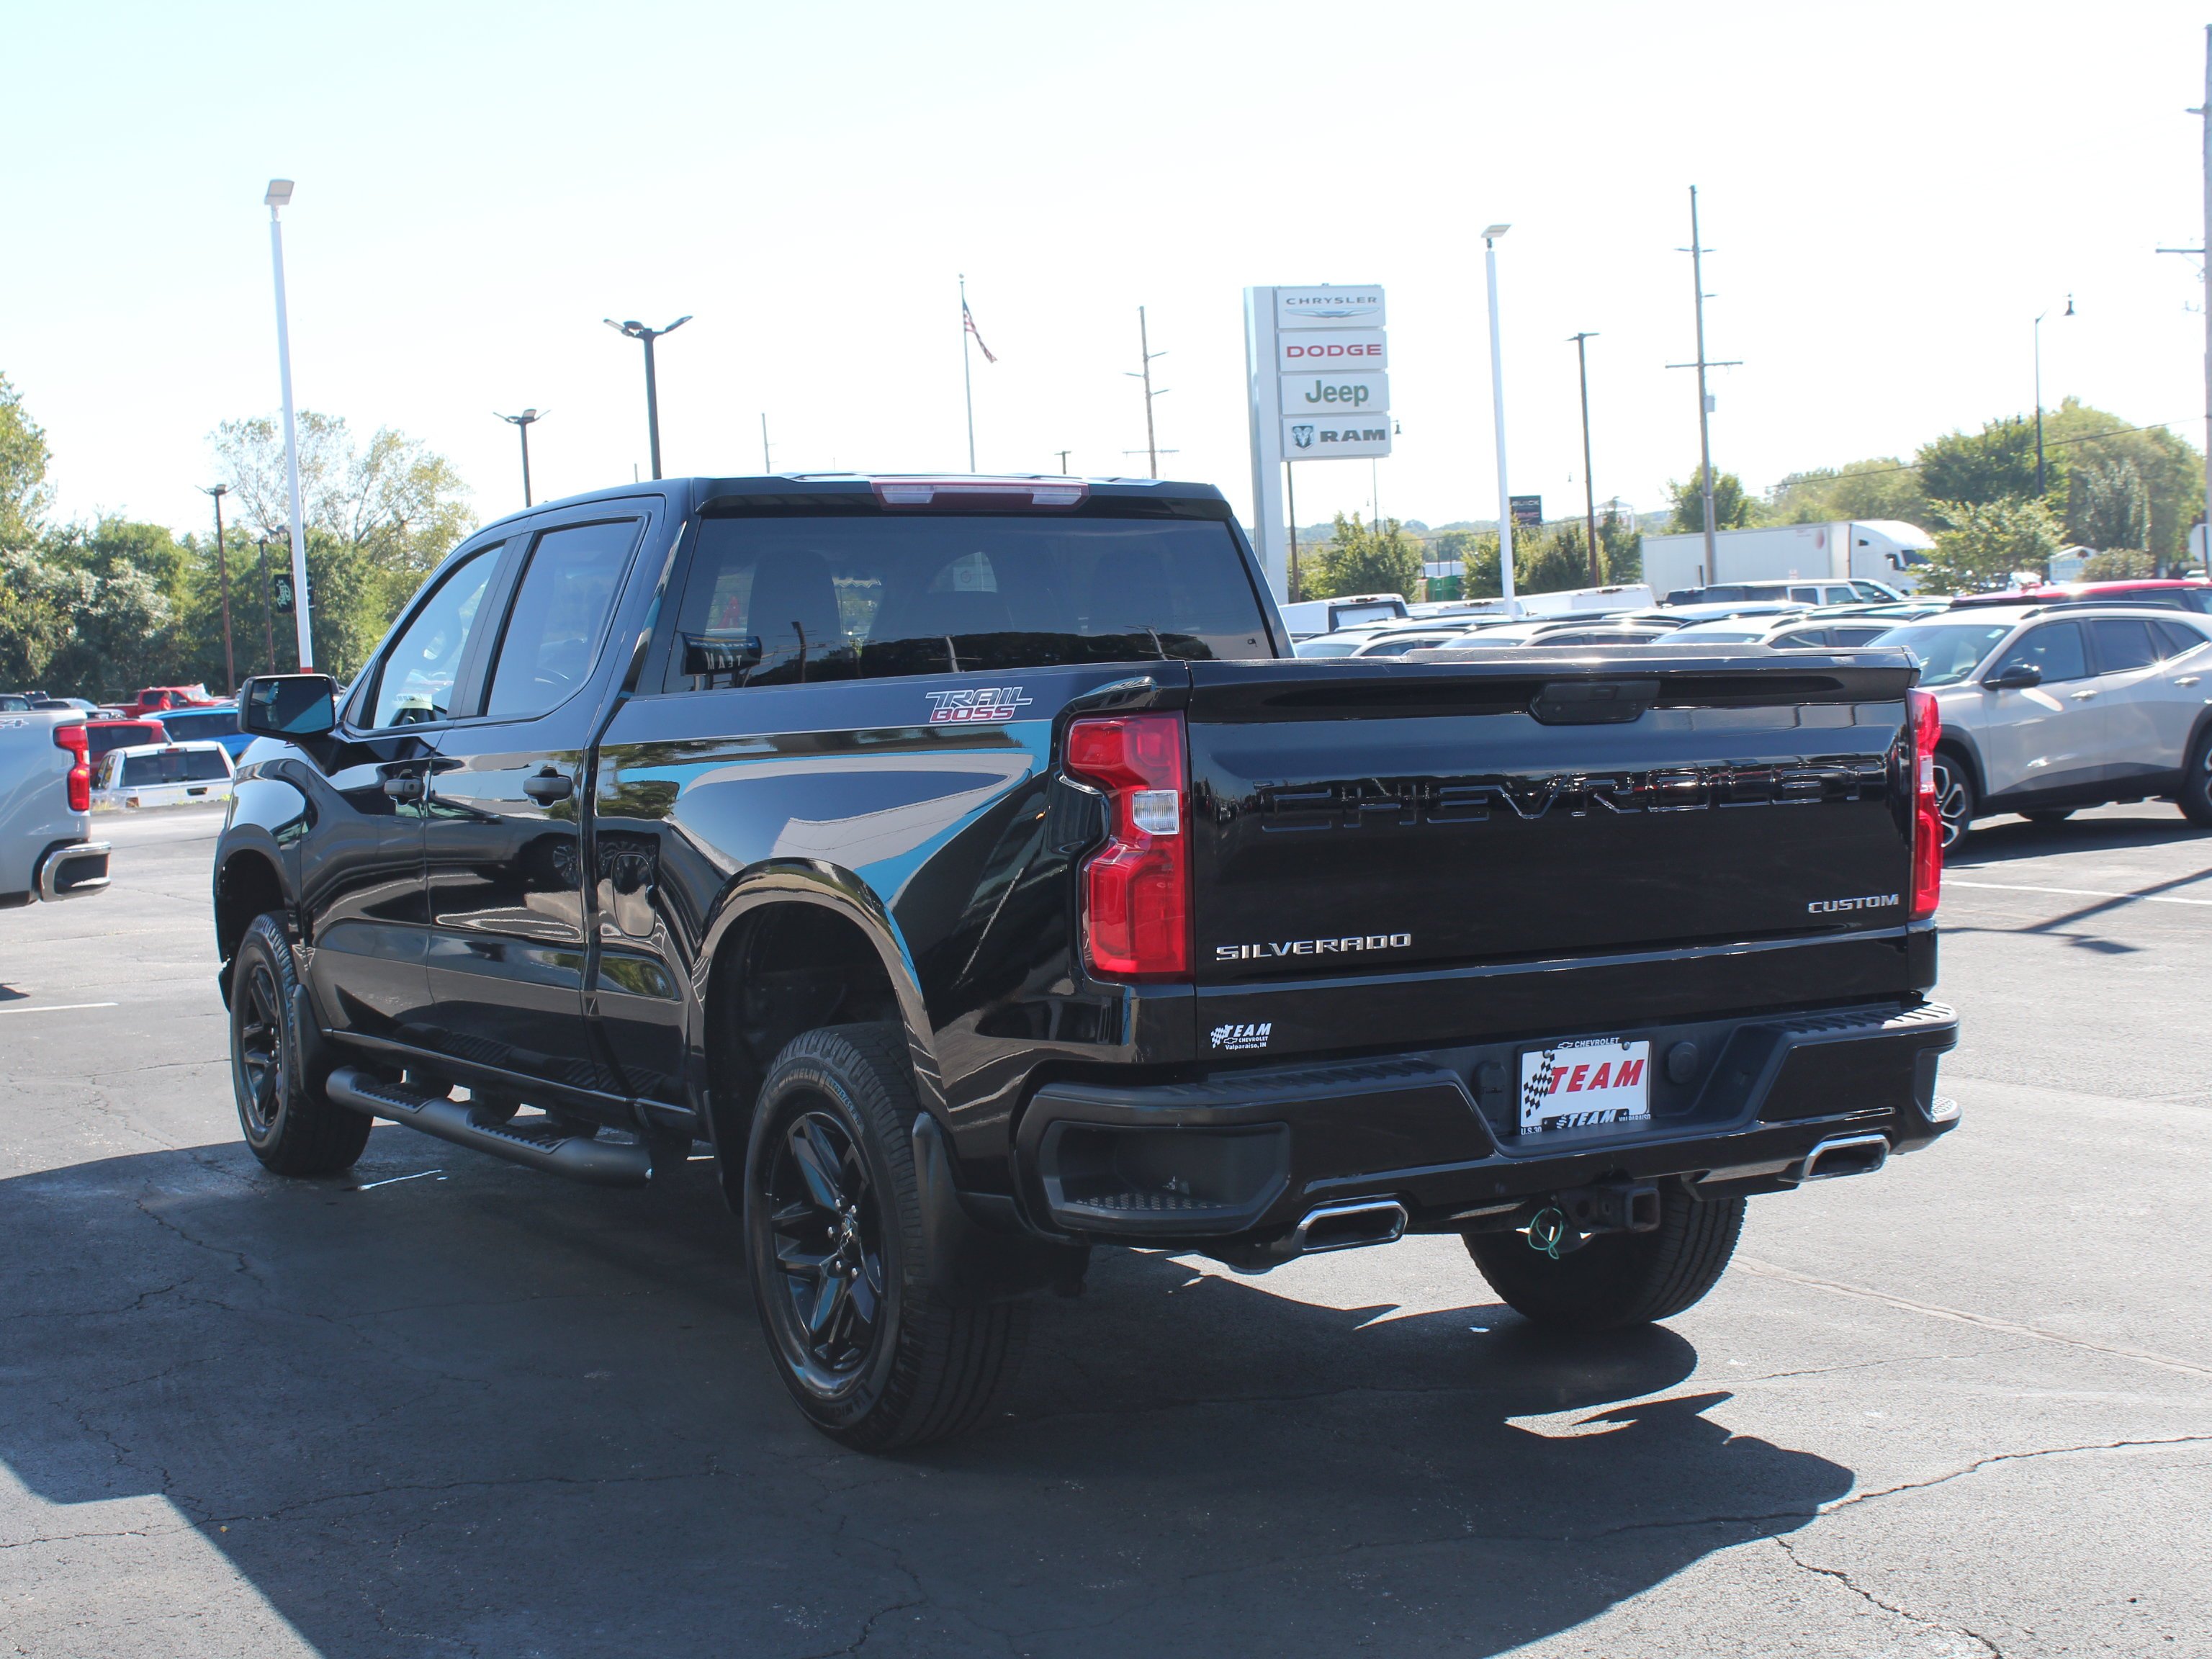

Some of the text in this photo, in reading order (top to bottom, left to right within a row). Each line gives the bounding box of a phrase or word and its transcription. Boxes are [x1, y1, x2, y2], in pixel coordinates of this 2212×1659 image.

[1286, 296, 1377, 305] CHRYSLER
[1287, 344, 1382, 358] DODGE
[1305, 380, 1370, 407] Jeep
[1320, 429, 1386, 442] RAM
[925, 686, 1033, 709] TRAIL
[929, 705, 1016, 724] BOSS
[1262, 759, 1881, 832] CHEVROLET
[1808, 894, 1899, 914] CUSTOM
[1215, 933, 1411, 961] SILVERADO
[1223, 1022, 1272, 1038] TEAM
[1574, 1037, 1620, 1048] CHEVROLET
[1547, 1059, 1645, 1094] TEAM
[1568, 1109, 1617, 1128] TEAM
